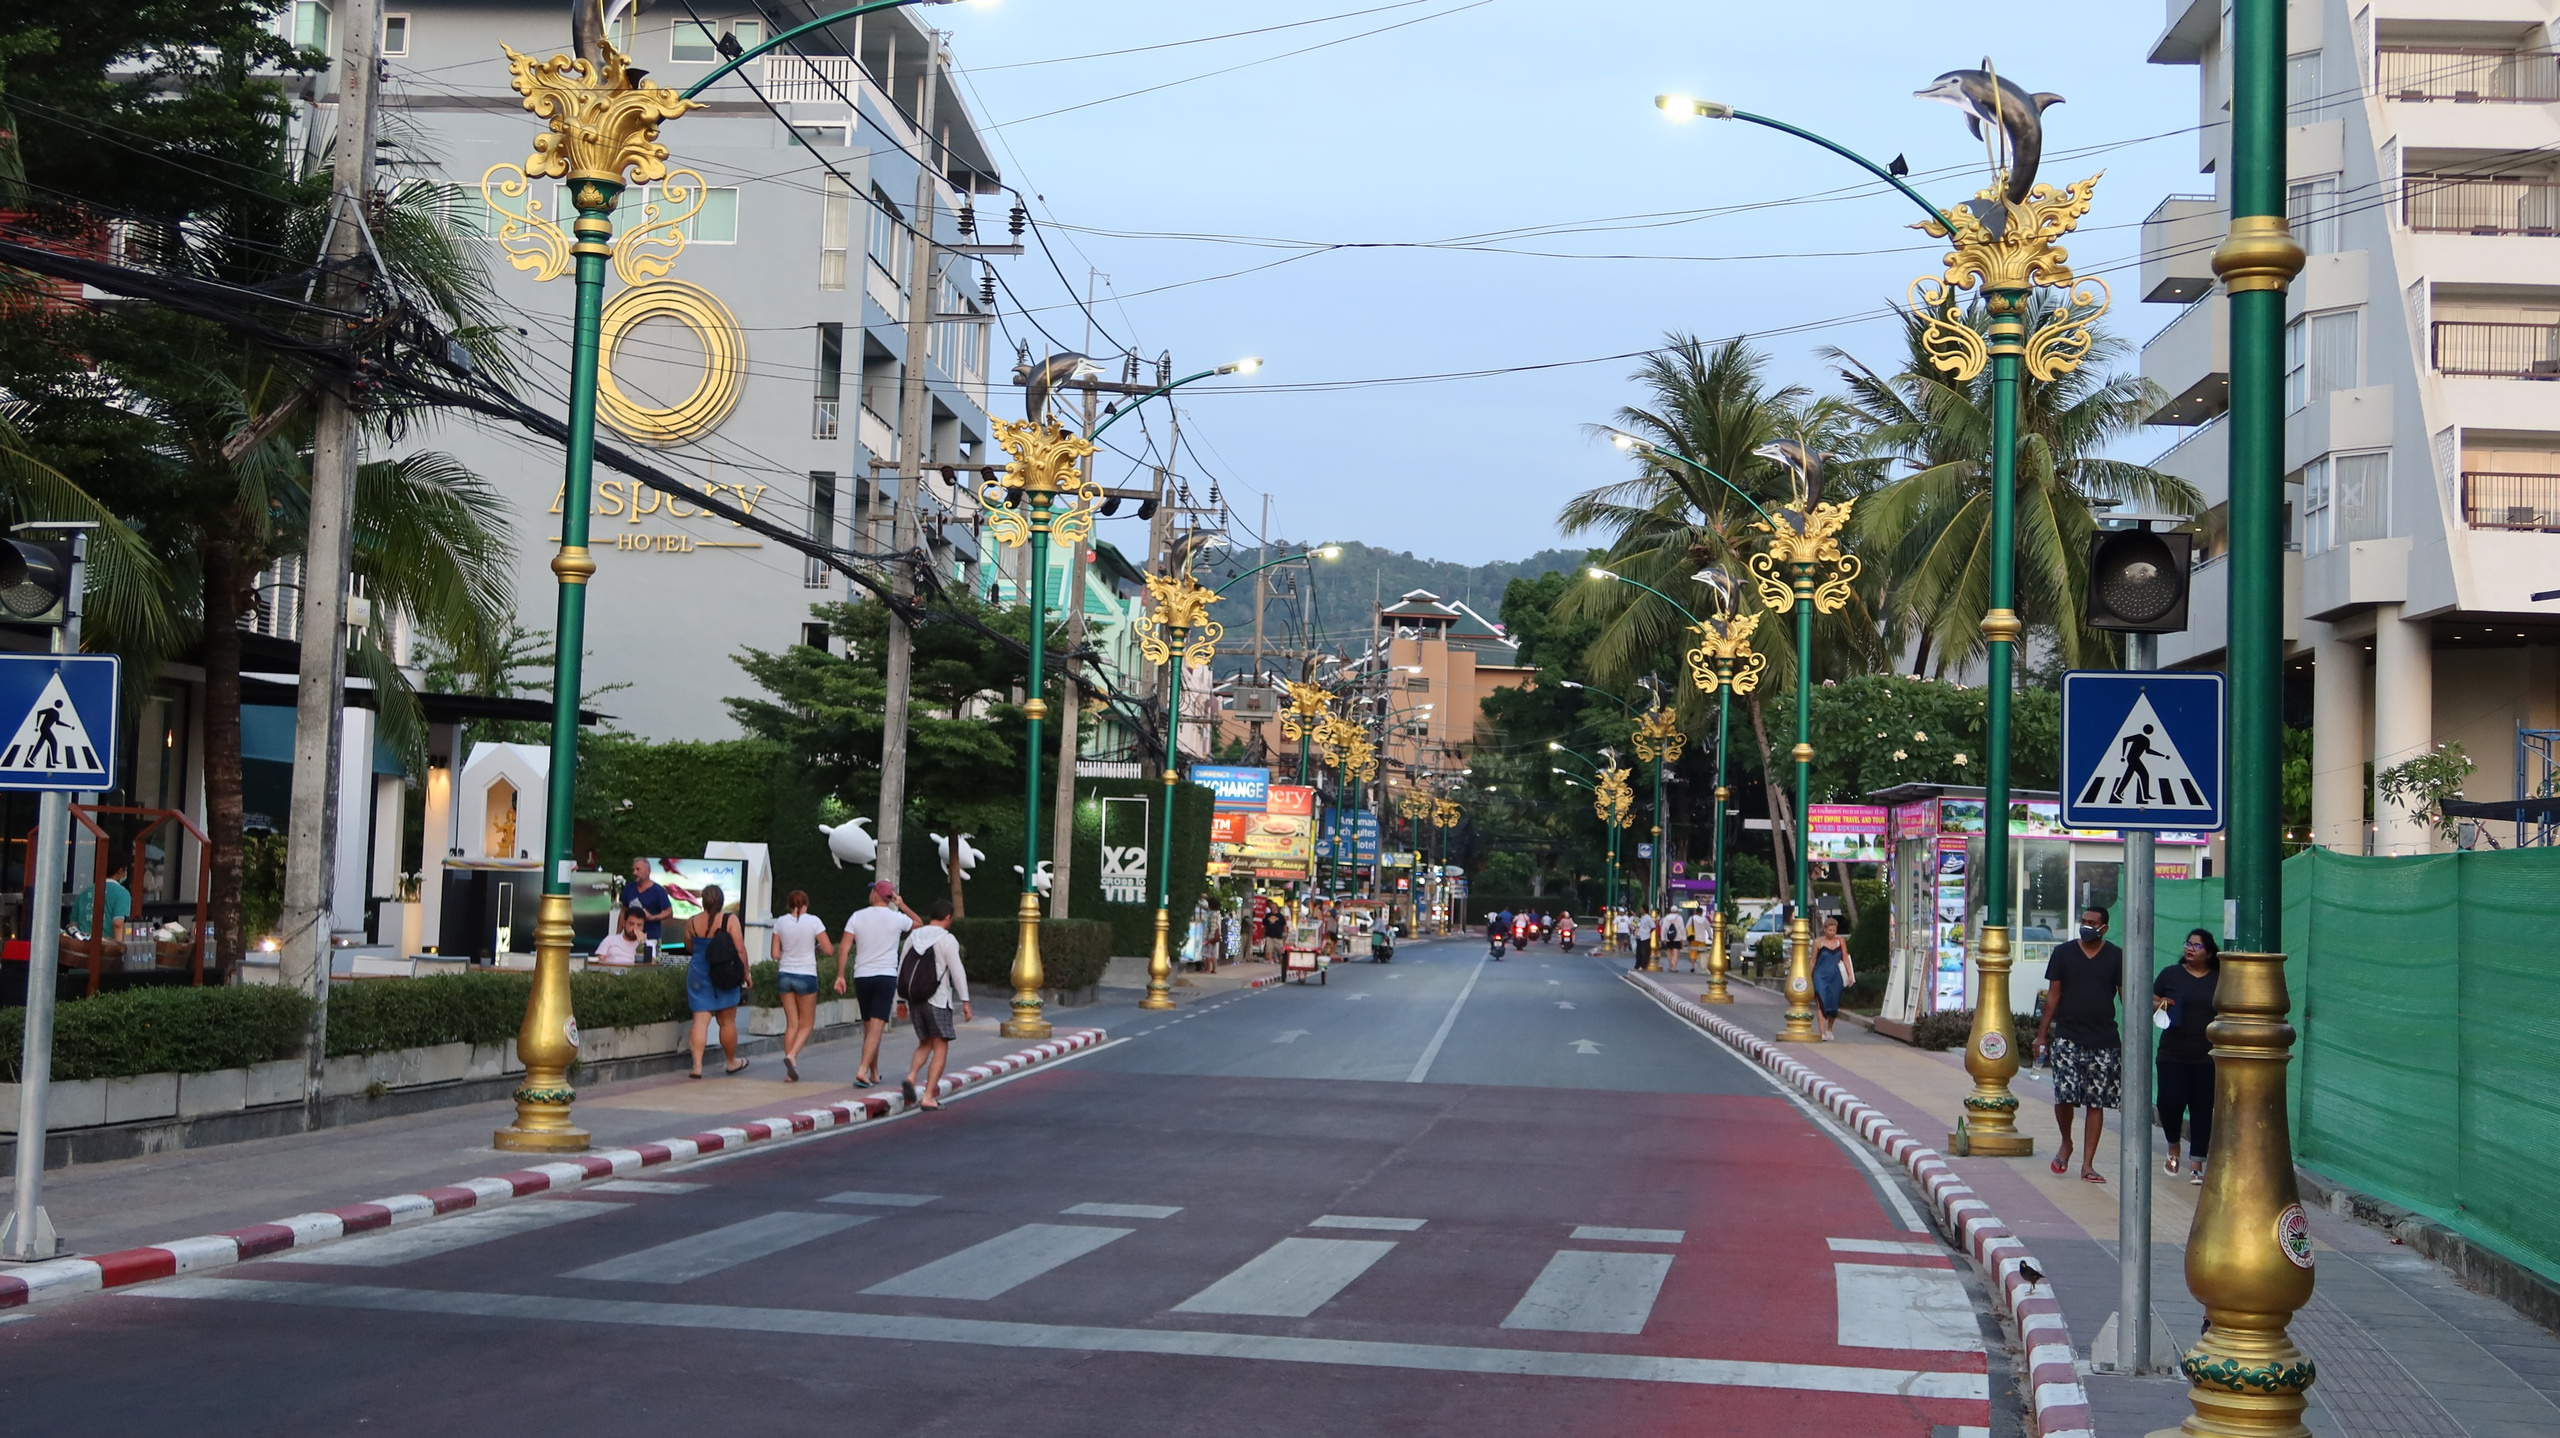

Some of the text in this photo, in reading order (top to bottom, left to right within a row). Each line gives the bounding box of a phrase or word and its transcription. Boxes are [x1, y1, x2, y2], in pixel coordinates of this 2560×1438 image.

[617, 533, 694, 552] HOTEL
[1195, 769, 1230, 779] CURRENCY
[1211, 818, 1231, 830] TM
[1808, 816, 1886, 824] HUKET EMPIRE TRAVEL AND TOUR
[1357, 829, 1377, 838] uites
[1102, 846, 1147, 874] X2
[1271, 860, 1306, 871] Massage
[702, 866, 735, 875] nam
[1100, 885, 1147, 902] VIBE
